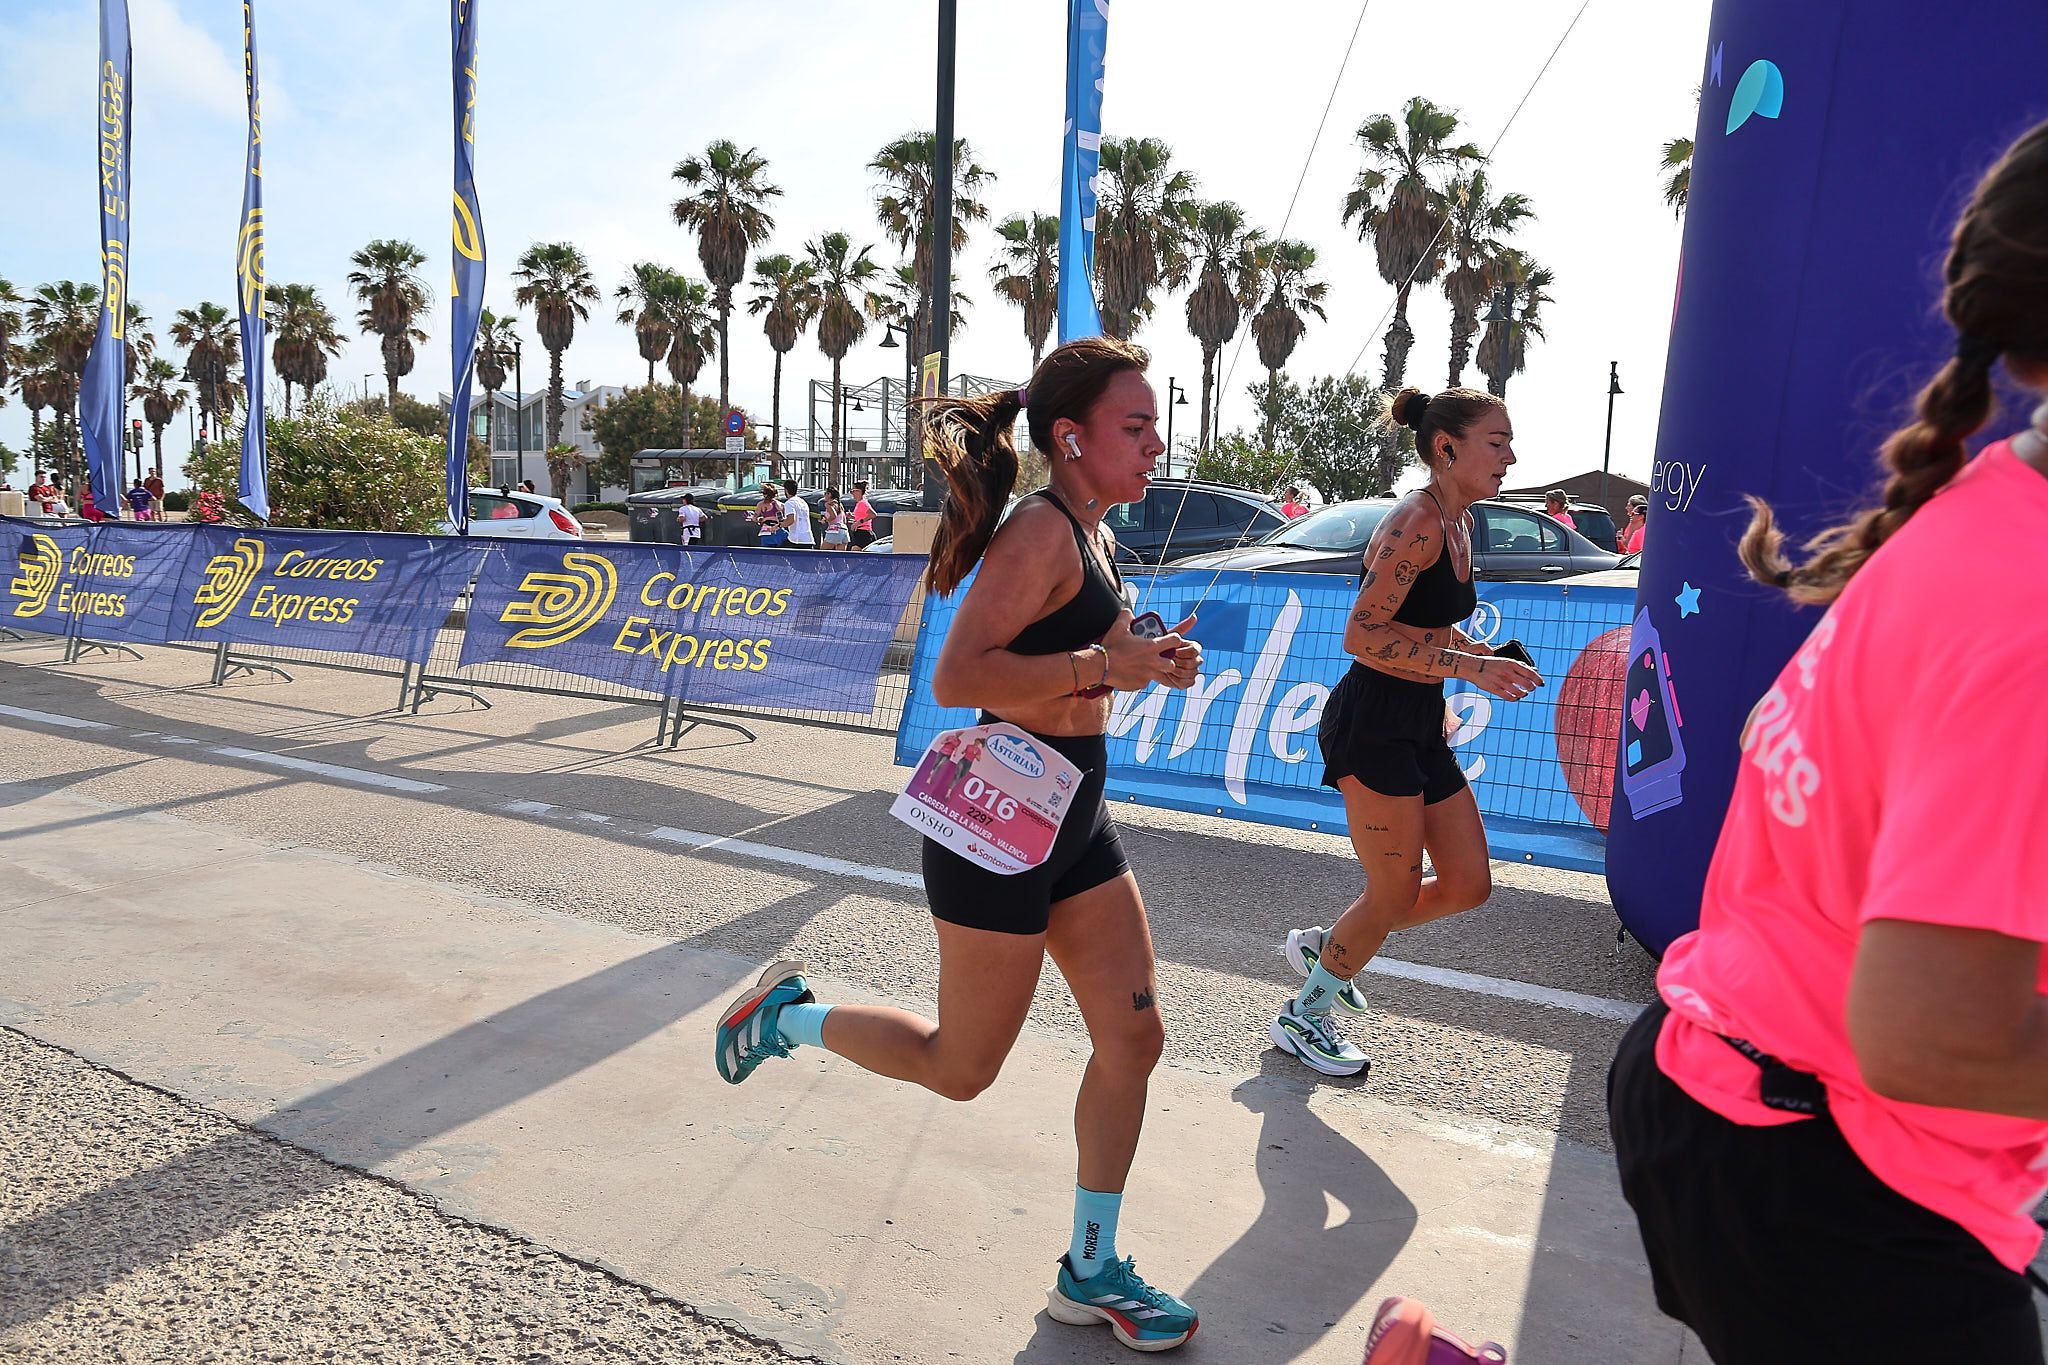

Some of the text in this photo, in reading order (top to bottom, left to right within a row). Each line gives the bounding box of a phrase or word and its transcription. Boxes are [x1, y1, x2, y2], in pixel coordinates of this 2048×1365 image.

[1652, 460, 1707, 512] ergy
[69, 546, 136, 578] Correos
[273, 549, 384, 582] Correos
[58, 583, 127, 622] Express
[249, 585, 360, 629] Express
[640, 572, 793, 617] Correos
[612, 615, 772, 672] Express
[989, 738, 1040, 776] ASTURIANA
[963, 776, 1019, 821] 016
[966, 806, 994, 827] 2297
[910, 807, 954, 838] OYSHO
[918, 791, 949, 815] CARRERA
[948, 809, 960, 821] DE
[958, 816, 969, 828] LA
[969, 822, 993, 841] MUJER
[997, 838, 1029, 862] VALENCIA
